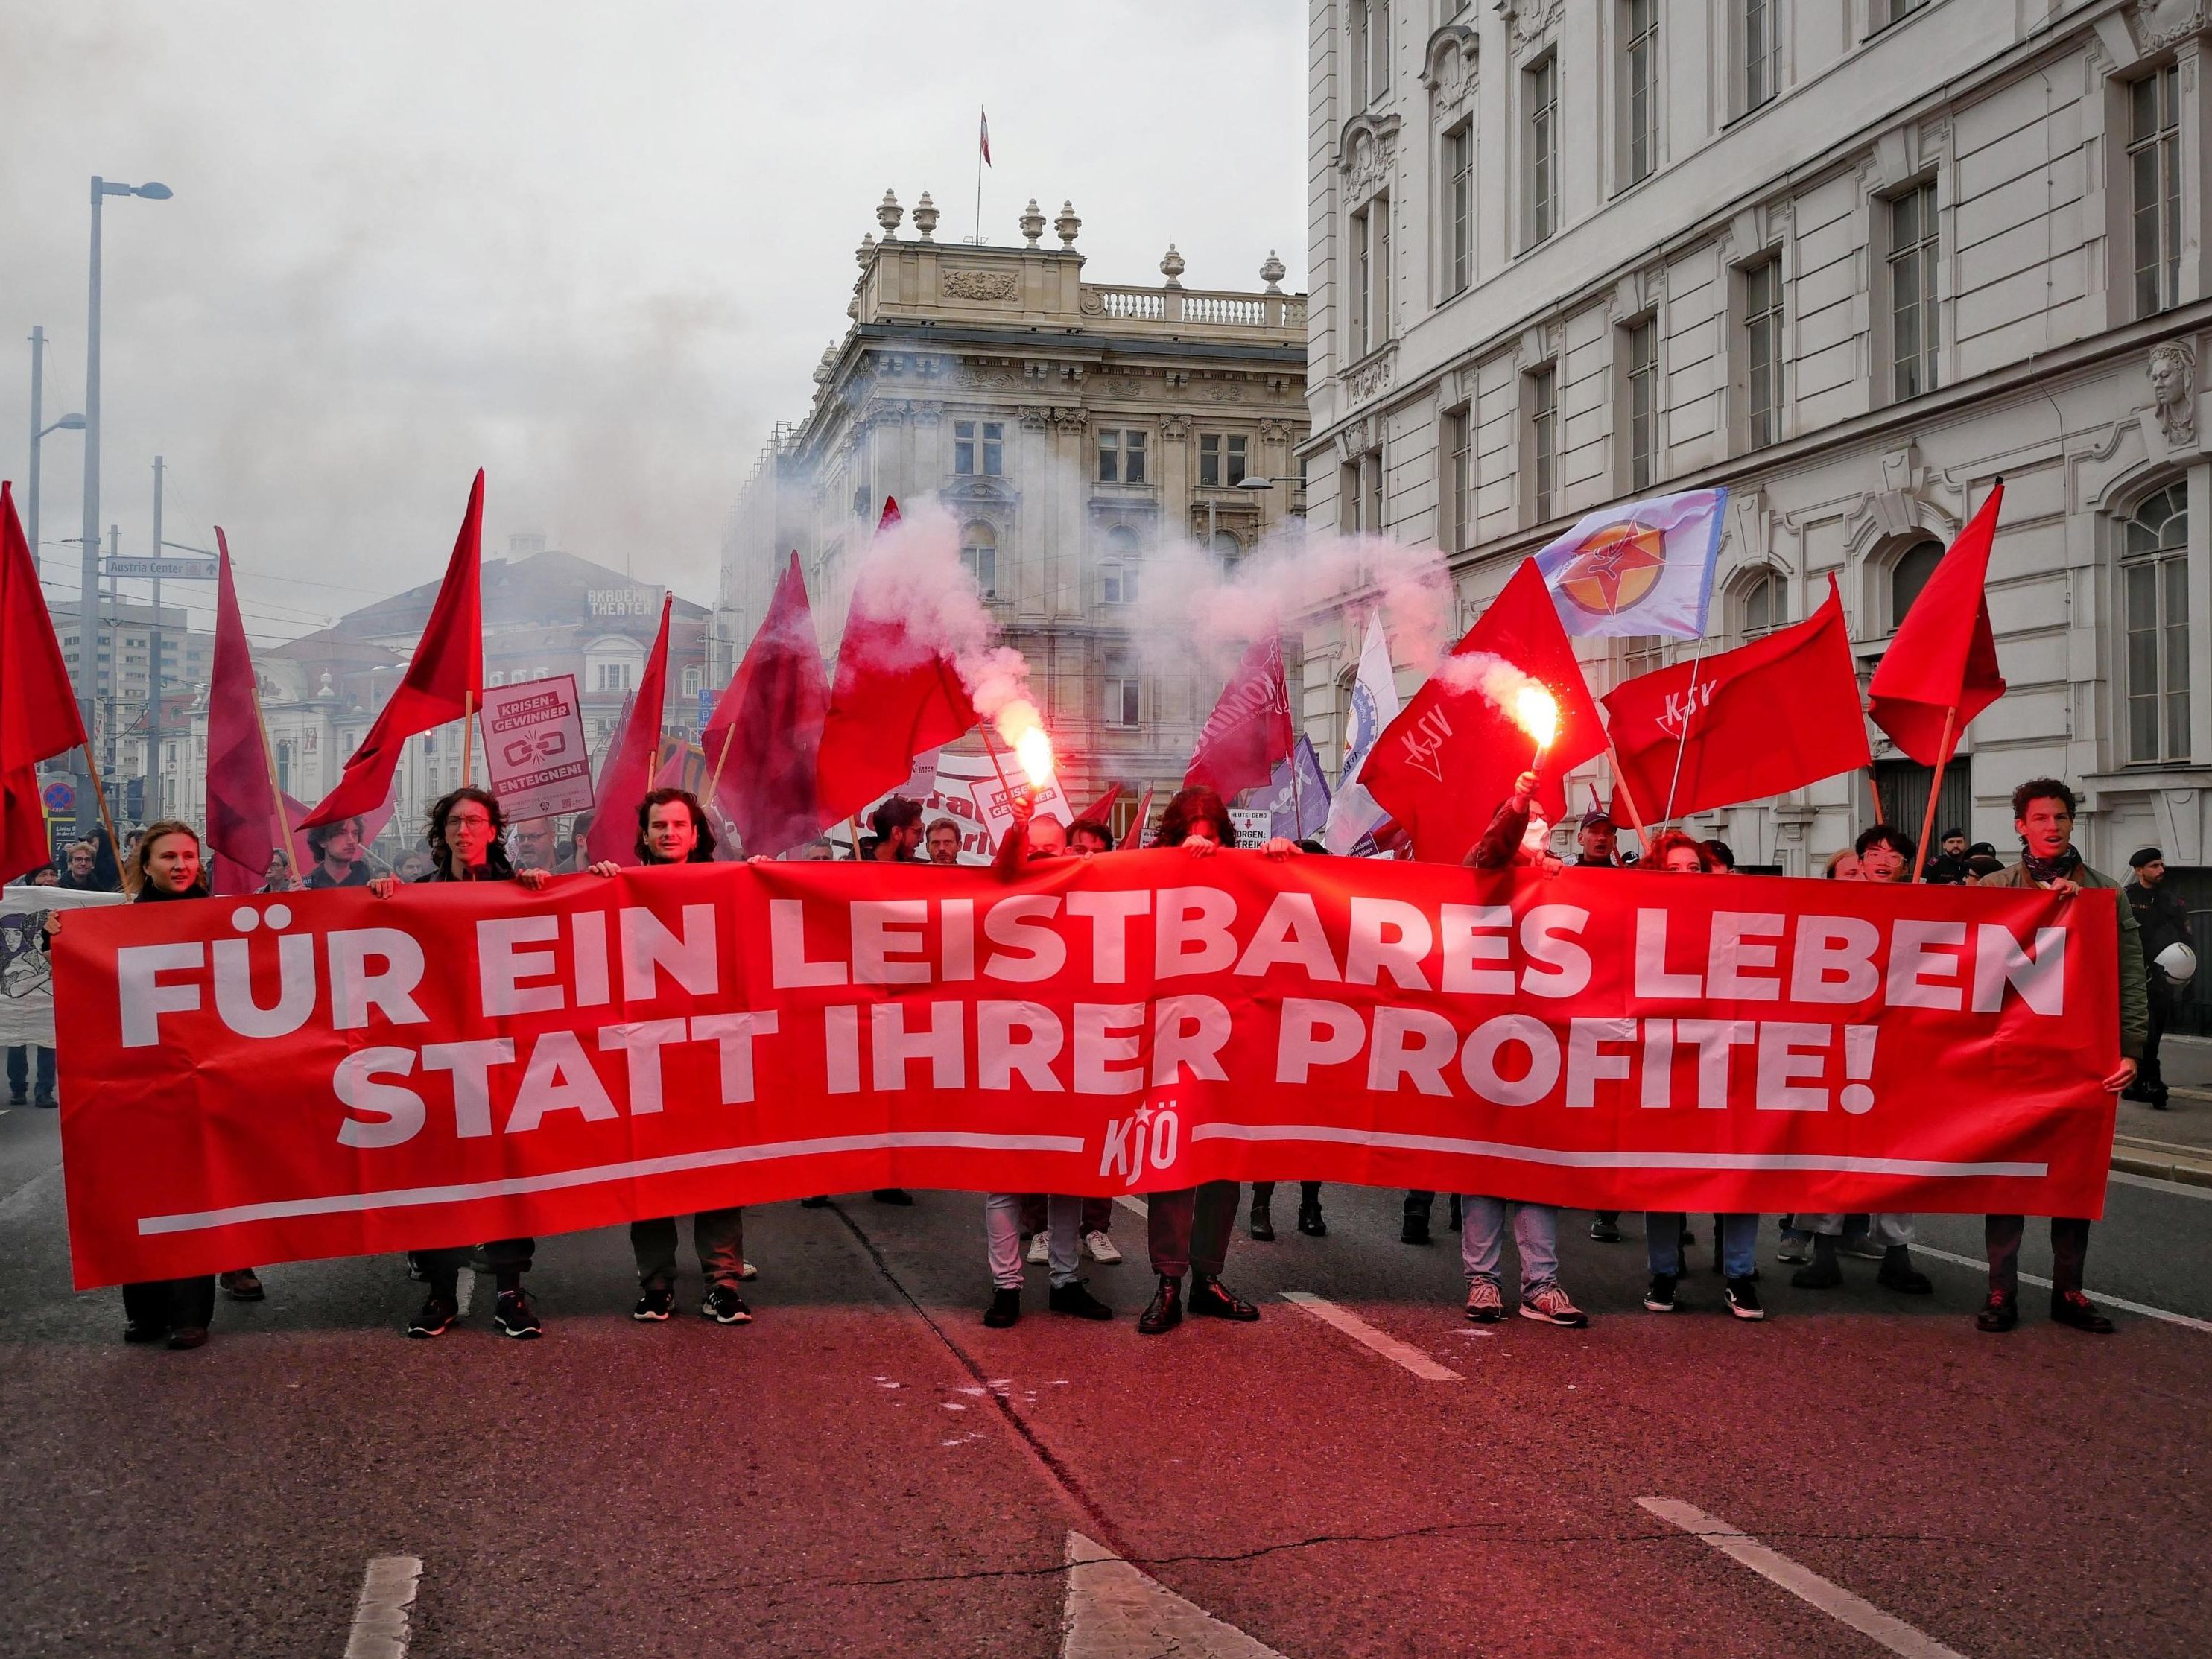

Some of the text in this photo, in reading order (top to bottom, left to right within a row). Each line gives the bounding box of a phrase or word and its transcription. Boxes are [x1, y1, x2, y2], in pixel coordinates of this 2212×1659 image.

[111, 562, 183, 573] Austria Center
[590, 602, 652, 615] THEATER
[501, 696, 554, 715] KRISEN-
[1665, 679, 1717, 726] KSV
[495, 705, 567, 731] GEWINNER
[1401, 704, 1453, 762] KSV
[498, 764, 583, 793] ENTEIGNEN!
[118, 886, 2067, 1047] FÜR EIN LEISTBARES LEBEN
[333, 994, 1879, 1148] STATT IHRER PROFITE!
